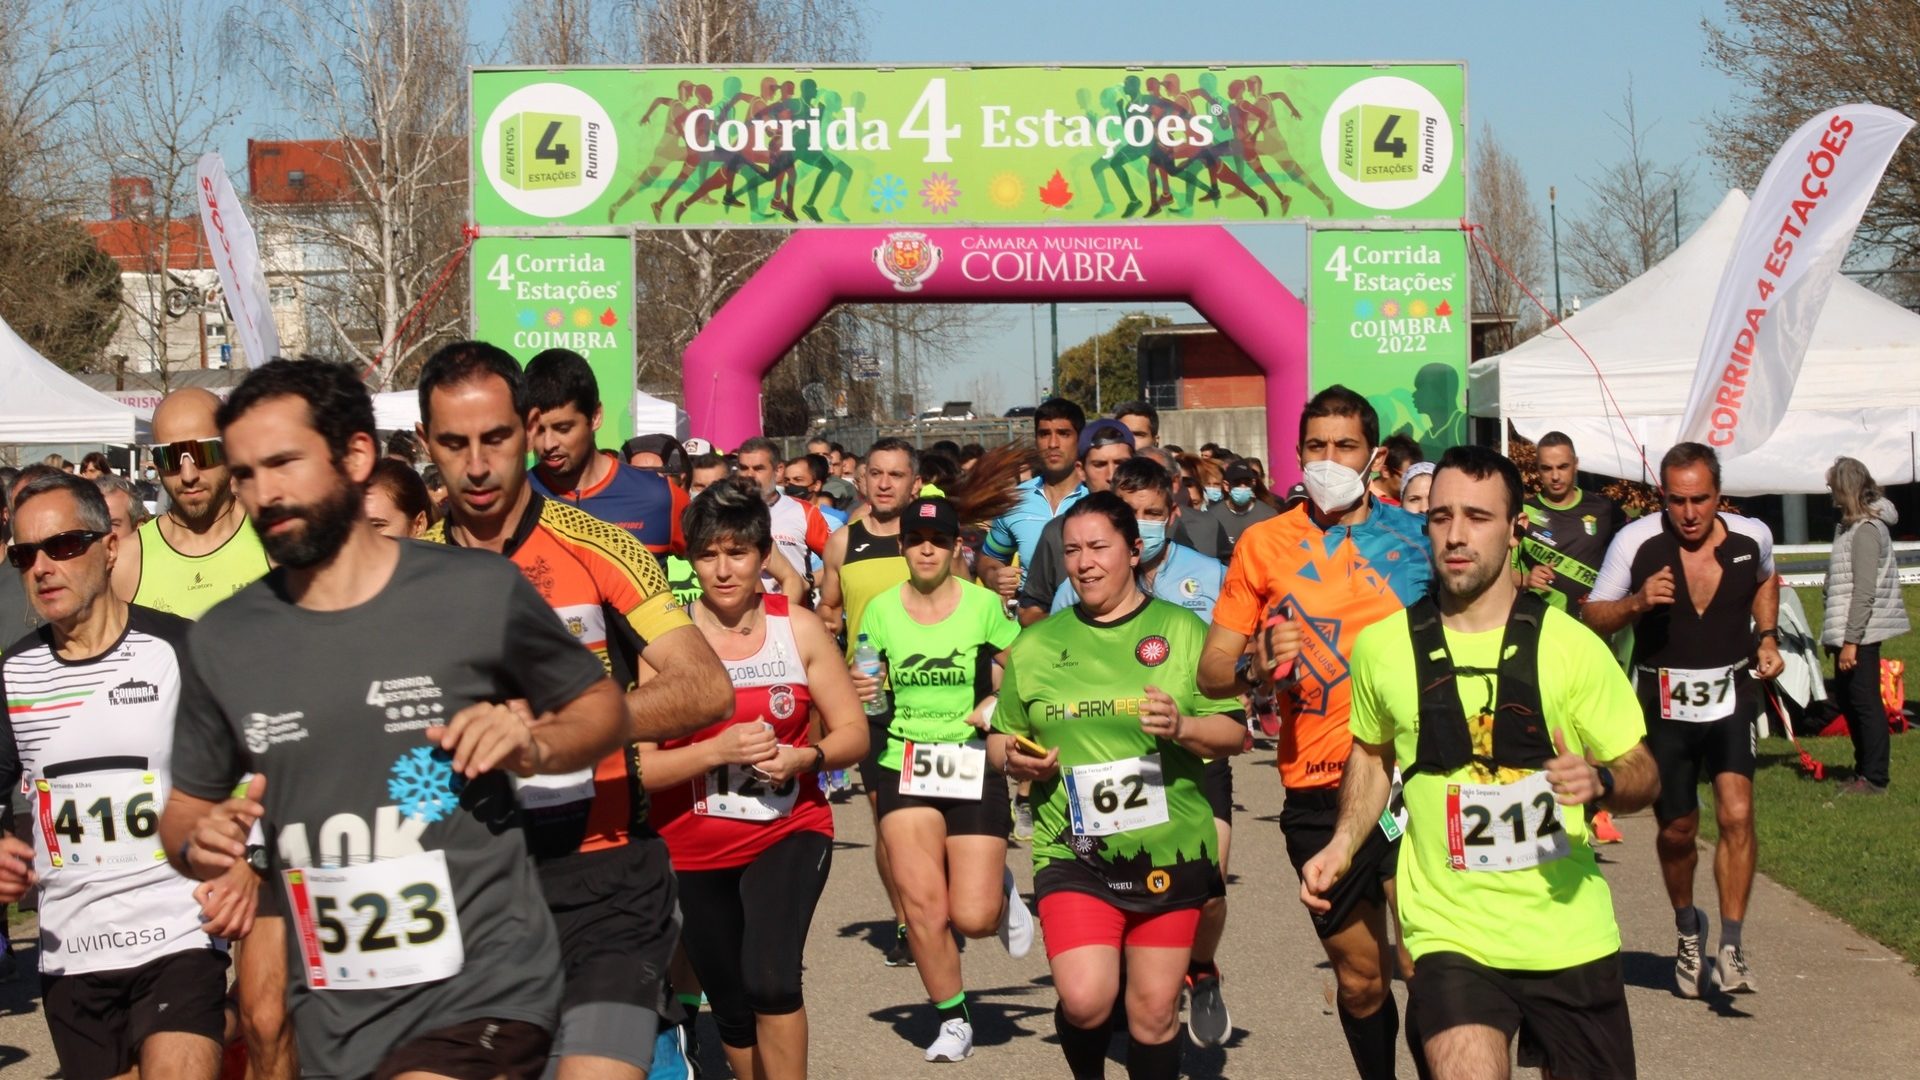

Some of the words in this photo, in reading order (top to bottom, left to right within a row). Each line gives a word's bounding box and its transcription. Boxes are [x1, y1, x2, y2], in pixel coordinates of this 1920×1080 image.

[683, 107, 892, 152] Corrida
[898, 77, 962, 163] 4
[1373, 114, 1407, 158] 4
[506, 127, 515, 175] EVENTOS
[535, 121, 570, 165] 4
[586, 122, 600, 179] Running
[1344, 119, 1354, 167] EVENTOS
[1422, 116, 1438, 174] Running
[528, 171, 577, 183] ESTAÇÕES
[1366, 164, 1414, 175] ESTAÇÕES
[1763, 115, 1854, 279] ESTAÇÕES
[516, 253, 606, 273] Corrida
[961, 235, 1038, 250] CÂMARA
[1042, 236, 1143, 254] MUNICIPAL
[1353, 245, 1441, 265] Corrida
[487, 253, 515, 291] 4
[961, 251, 1147, 283] COIMBRA
[1324, 245, 1352, 282] 4
[1757, 277, 1775, 302] 4
[514, 331, 617, 349] COIMBRA
[1350, 317, 1452, 338] COIMBRA
[1376, 334, 1427, 354] 2022
[1708, 307, 1767, 447] CORRIDA
[112, 685, 155, 698] COIMBRA
[894, 671, 966, 687] ACADEMIA
[1671, 678, 1732, 707] 437
[1092, 774, 1148, 814] 62
[55, 792, 159, 844] 416
[1462, 791, 1561, 847] 212
[314, 883, 446, 954] 523
